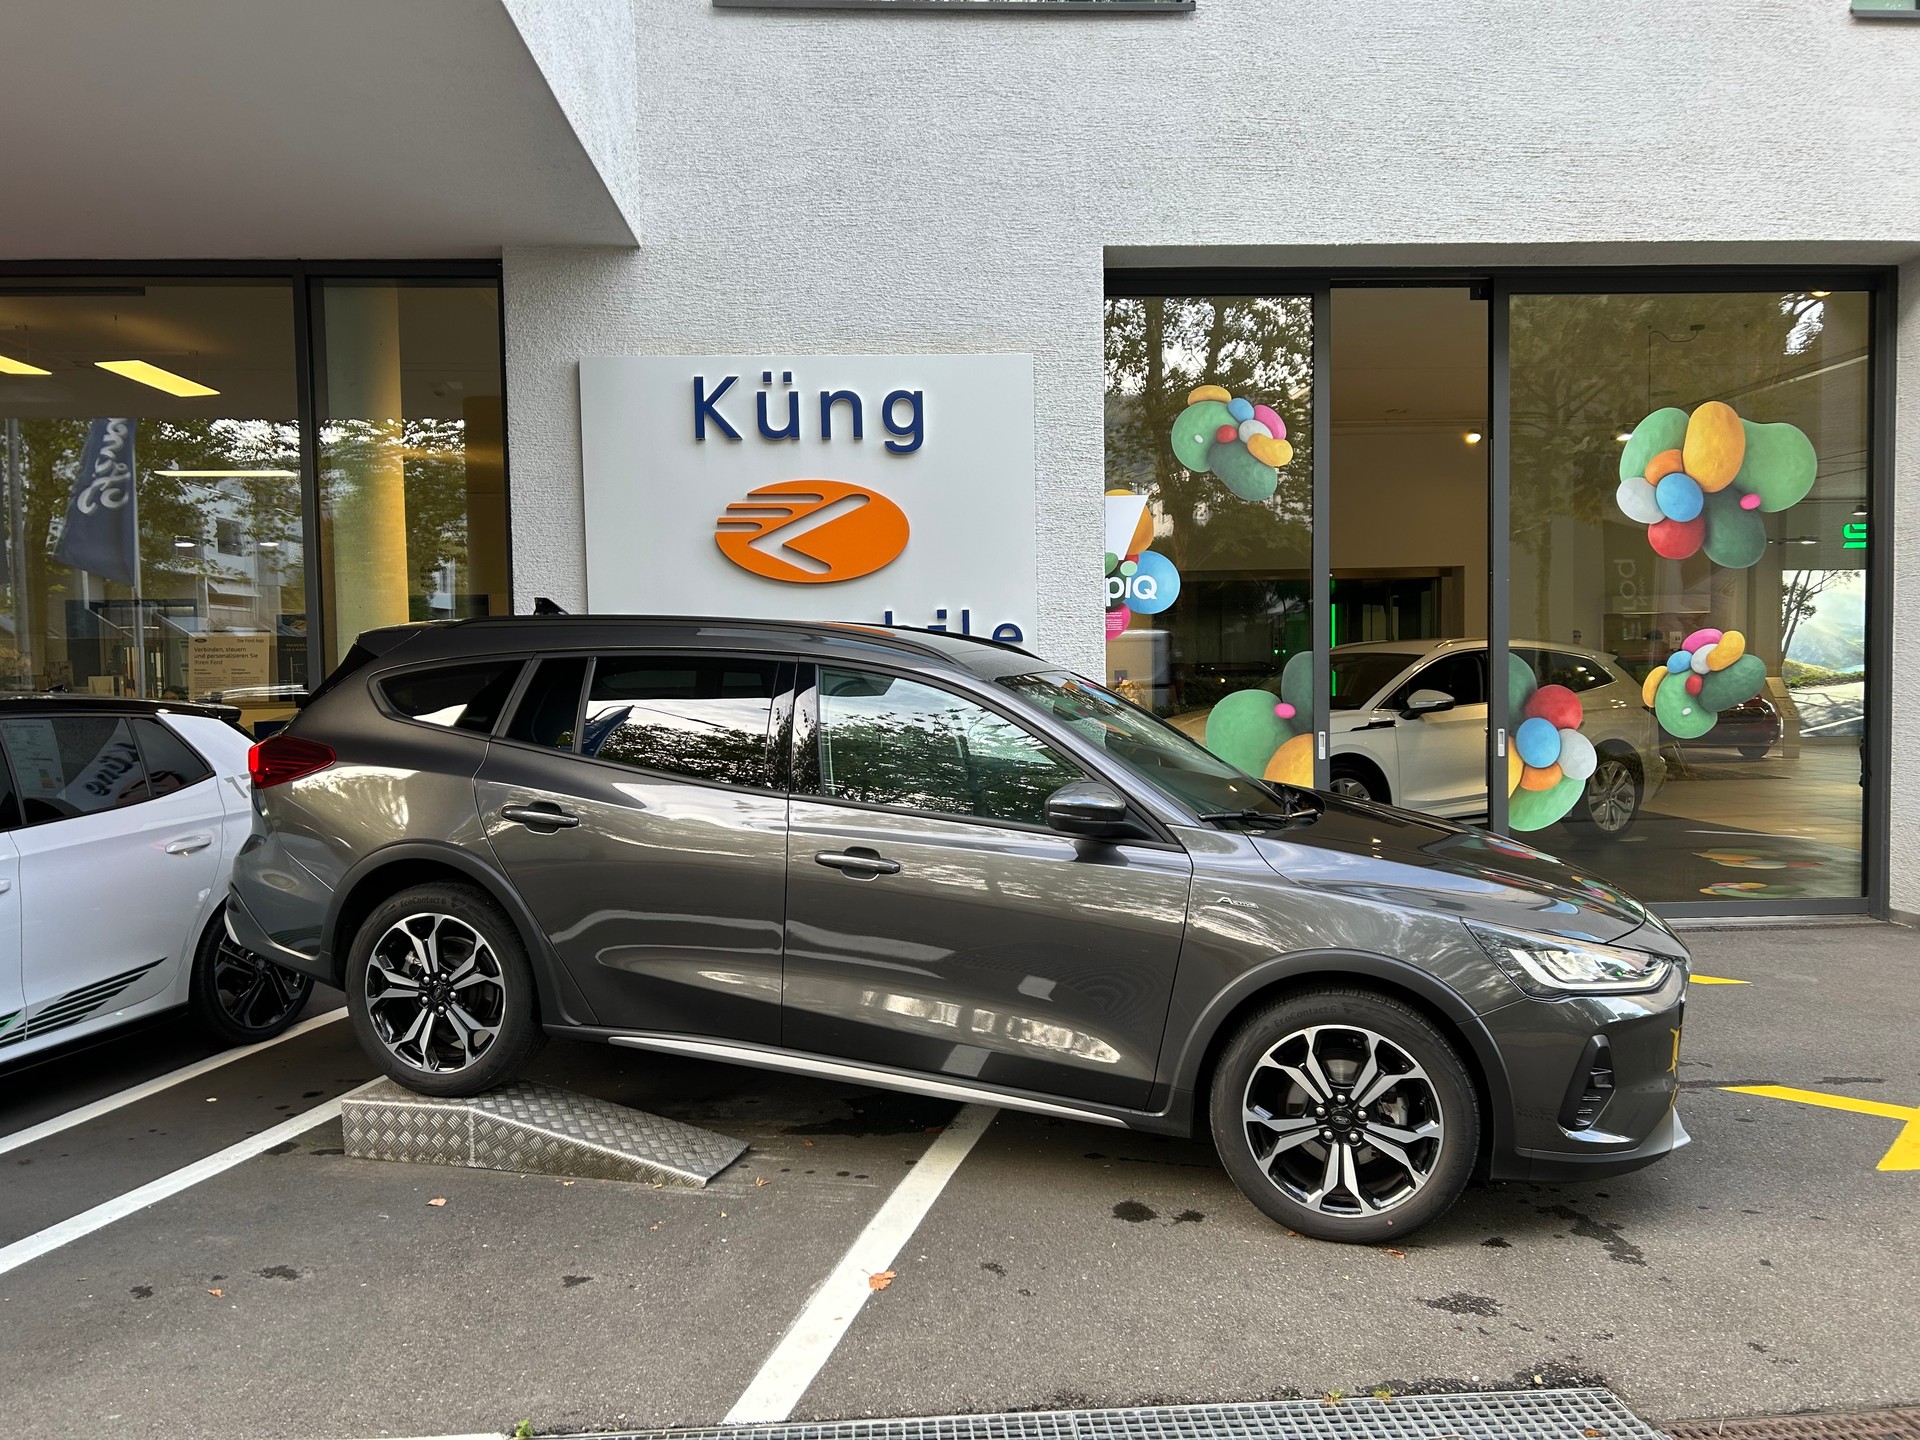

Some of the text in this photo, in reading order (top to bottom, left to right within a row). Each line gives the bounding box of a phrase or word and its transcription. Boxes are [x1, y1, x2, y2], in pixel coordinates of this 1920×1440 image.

[693, 371, 924, 453] Küng
[1273, 1004, 1338, 1027] EcoContact 6
